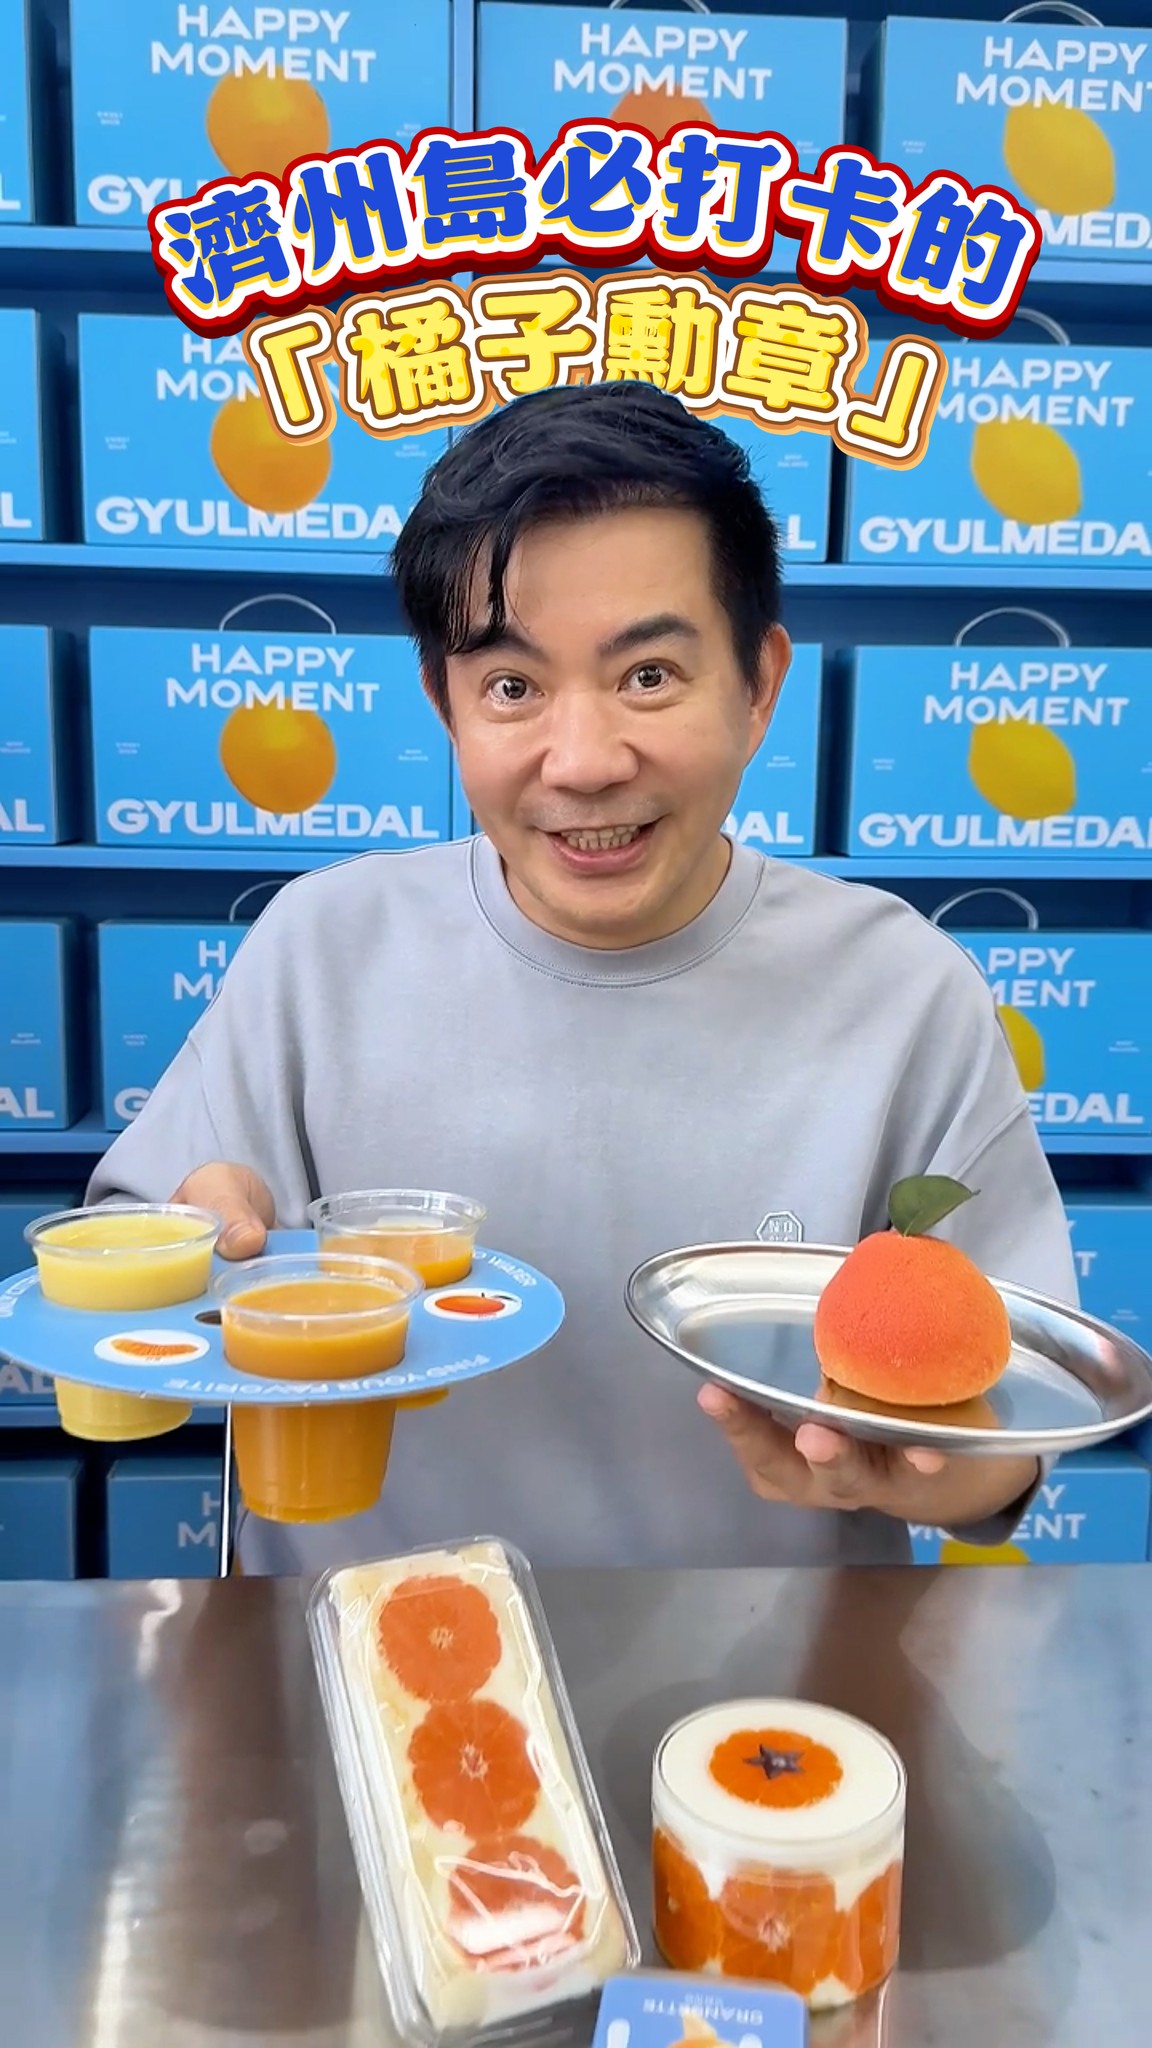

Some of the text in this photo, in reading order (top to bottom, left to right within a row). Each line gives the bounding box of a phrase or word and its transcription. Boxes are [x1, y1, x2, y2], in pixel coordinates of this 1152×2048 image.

[178, 4, 350, 43] HAPPY
[150, 44, 377, 84] MOMENT
[580, 22, 748, 68] HAPPY
[984, 36, 1148, 75] HAPPY
[553, 60, 772, 101] MOMENT
[956, 72, 1152, 113] MOMEN
[1036, 208, 1152, 249] MED
[952, 357, 1112, 391] HAPPY
[96, 497, 413, 540] GYULMEDA
[191, 643, 355, 677] HAPPY
[950, 661, 1108, 692] HAPPY
[166, 678, 380, 712] MOMENT
[924, 696, 1130, 726] MOMENT
[106, 799, 440, 839] GYULMEDAL
[858, 812, 1152, 848] GYULMEDA
[163, 1354, 491, 1394] FIND YOUR FAVORITE
